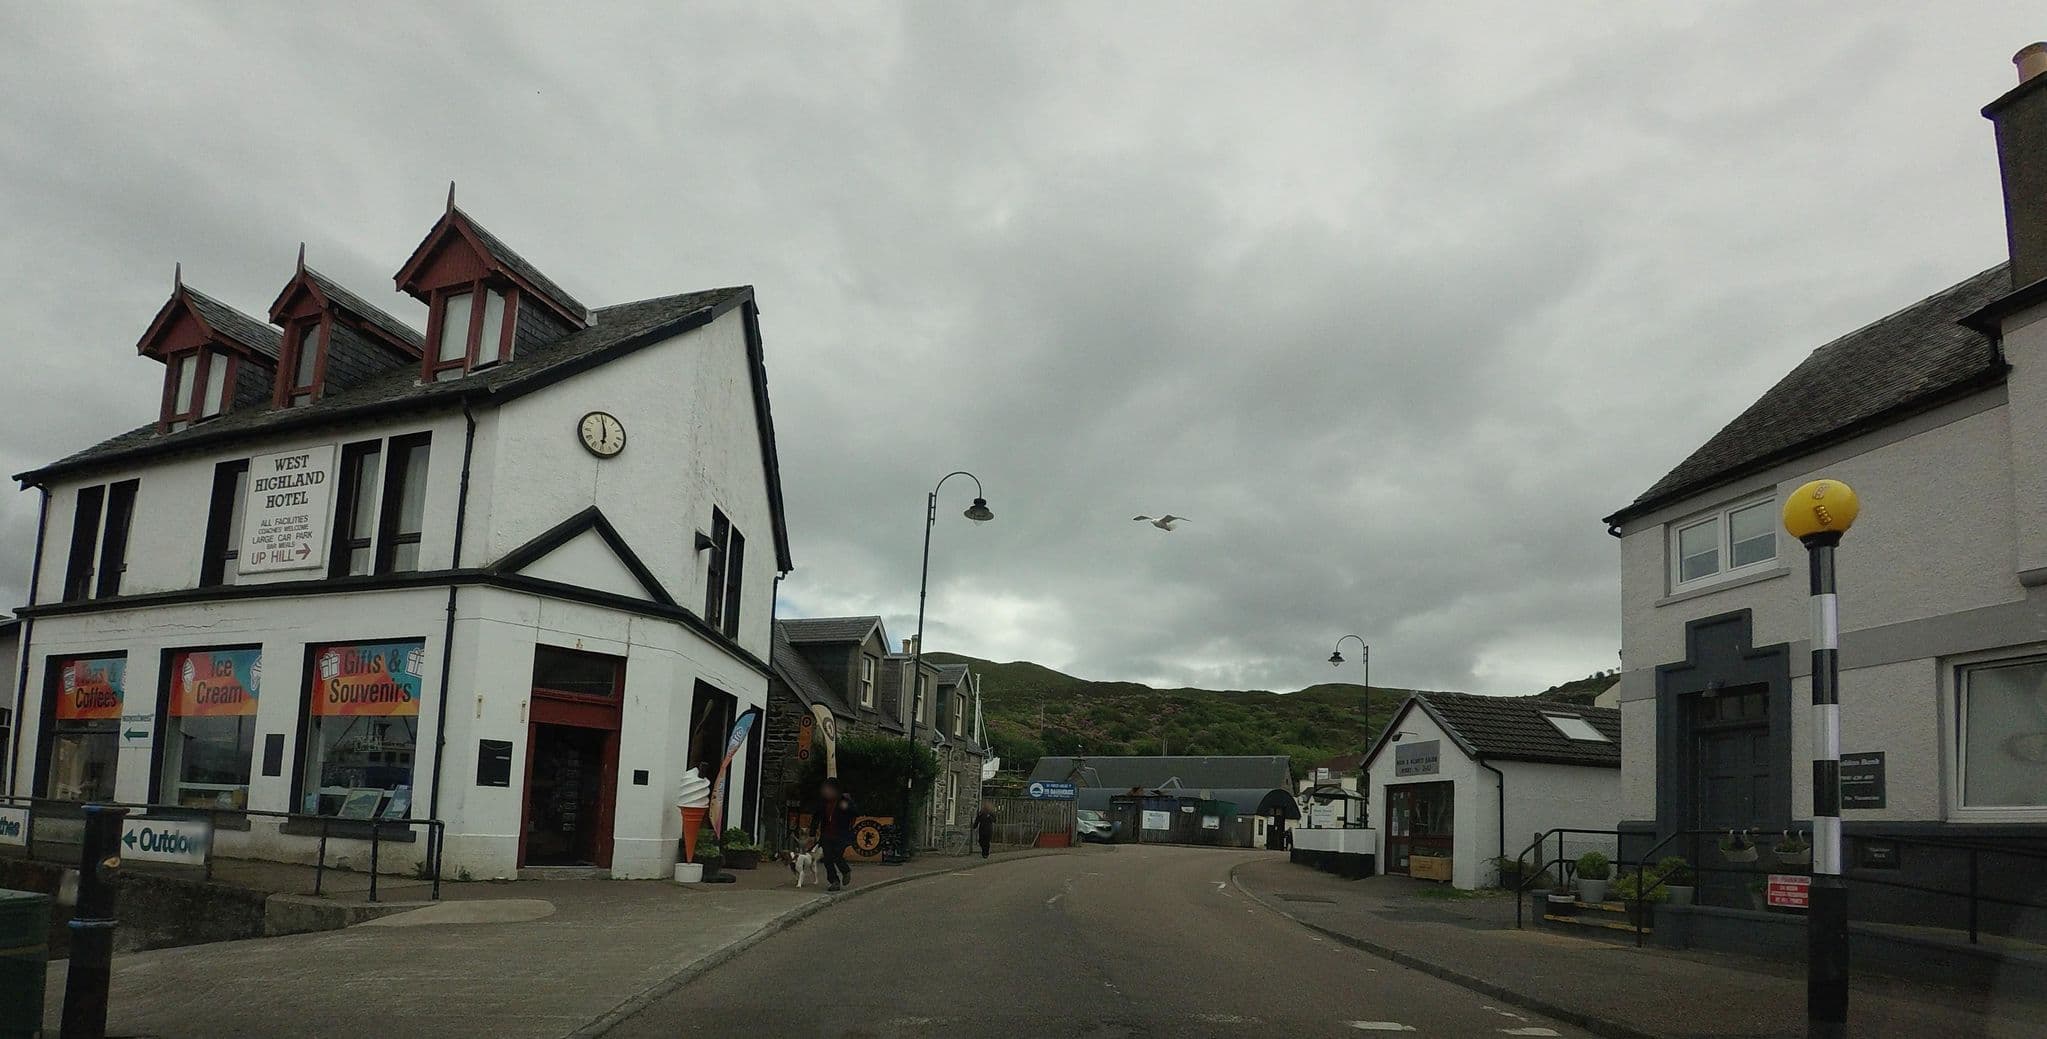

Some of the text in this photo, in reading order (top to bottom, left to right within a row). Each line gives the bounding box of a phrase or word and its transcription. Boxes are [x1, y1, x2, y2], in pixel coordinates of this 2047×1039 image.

[274, 454, 310, 472] WEST
[254, 470, 325, 493] HIGHLAND
[265, 491, 309, 509] HOTEL
[260, 515, 309, 527] ALL FACILITIES
[283, 524, 309, 532] WELCOME
[252, 531, 313, 545] LARGE CAR PARK
[278, 541, 296, 549] MEALS
[251, 549, 295, 565] UP HILL
[210, 655, 233, 677] Ice
[344, 647, 401, 675] Gifts &
[75, 687, 117, 709] Coffees
[196, 681, 242, 704] Cream
[329, 677, 412, 704] Souvenirs
